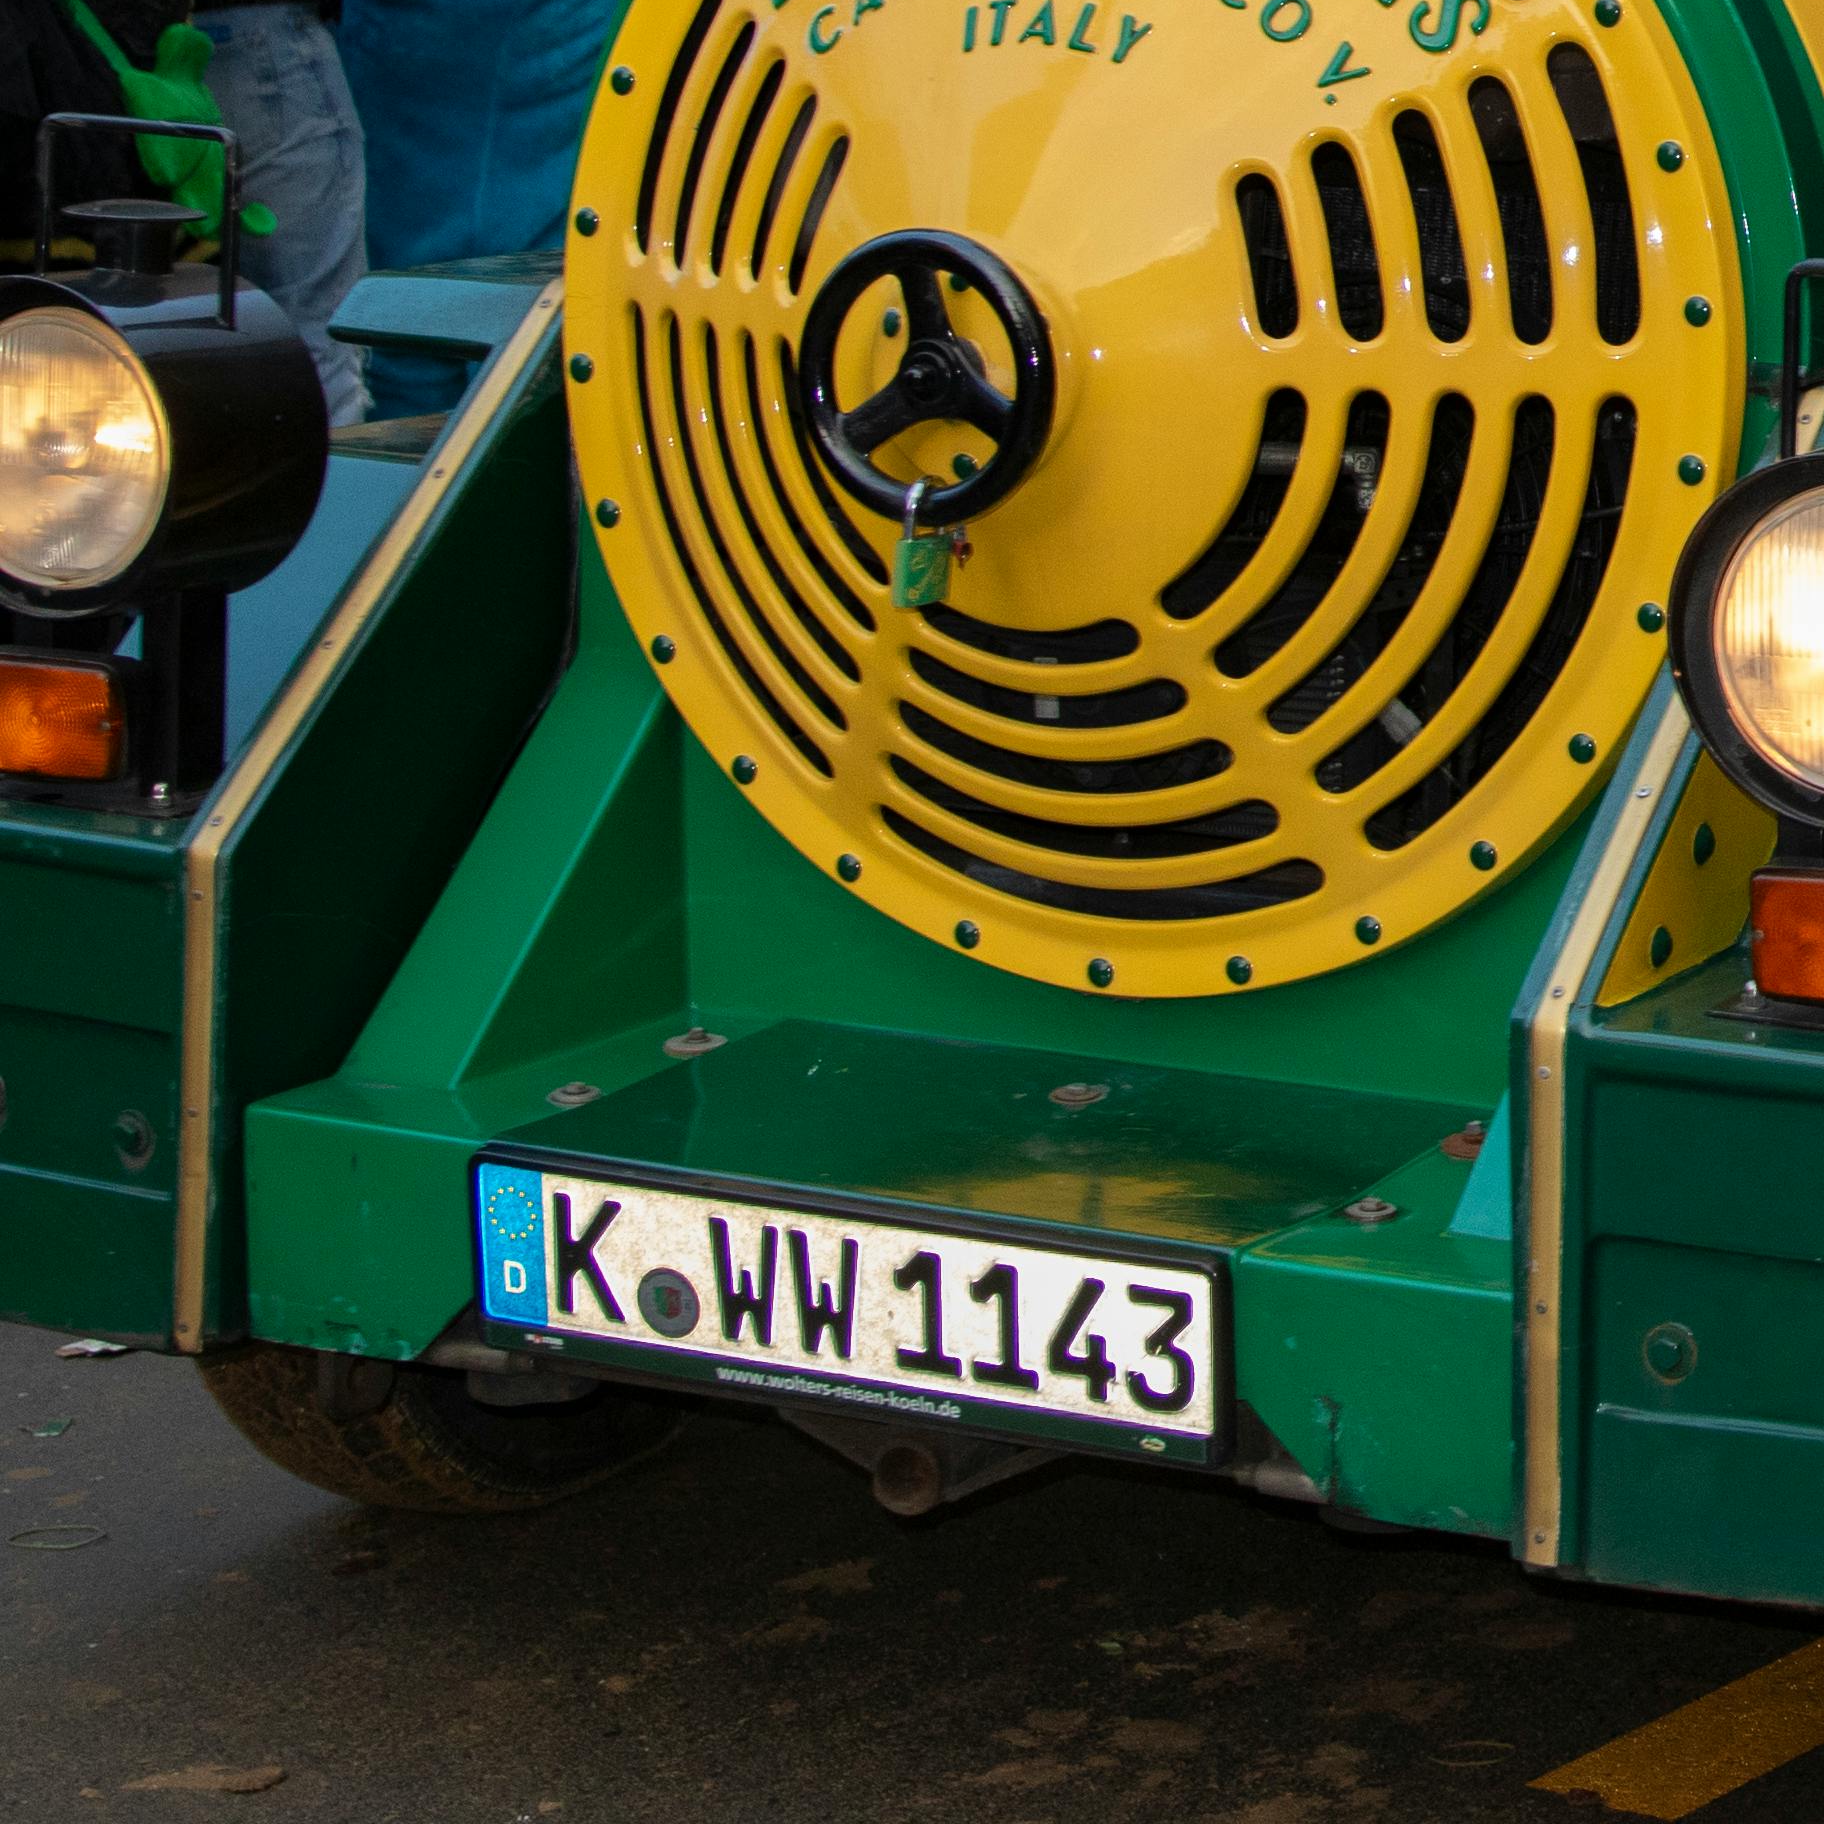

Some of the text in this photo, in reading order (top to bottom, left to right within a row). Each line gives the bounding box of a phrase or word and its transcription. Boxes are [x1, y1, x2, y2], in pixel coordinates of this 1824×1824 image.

[503, 1260, 527, 1294] D
[553, 1191, 626, 1324] K
[709, 1217, 859, 1360] WW
[894, 1250, 1196, 1415] 1143
[716, 1366, 961, 1417] www.wolters-reisen-koeln.de
